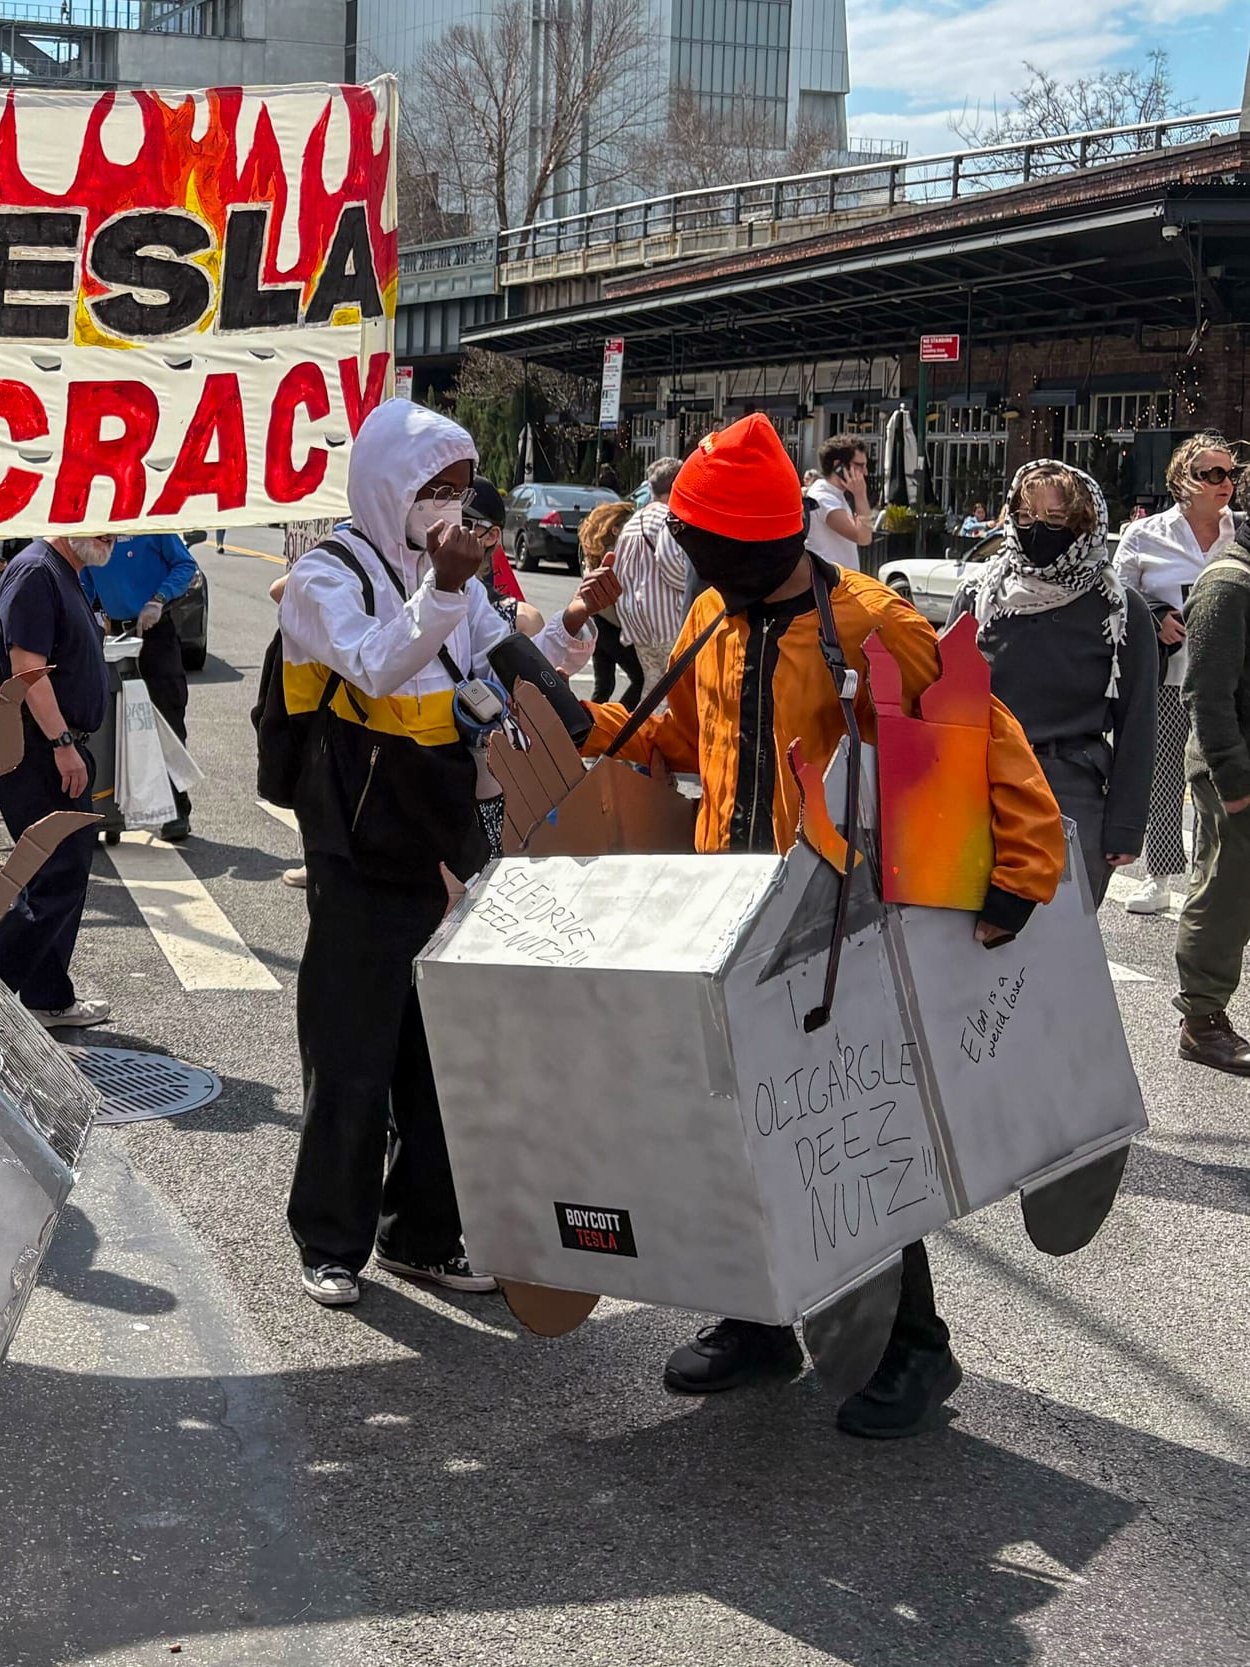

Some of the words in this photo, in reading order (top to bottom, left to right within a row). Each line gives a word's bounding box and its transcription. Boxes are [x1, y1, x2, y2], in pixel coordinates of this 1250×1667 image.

[471, 897, 520, 935] DEEZ
[998, 976, 1009, 988] a
[988, 1010, 1011, 1058] weird
[1002, 966, 1026, 1010] loser
[794, 1100, 912, 1192] DEEZ
[565, 1208, 621, 1232] BOYCOTT
[575, 1228, 619, 1251] TESLA
